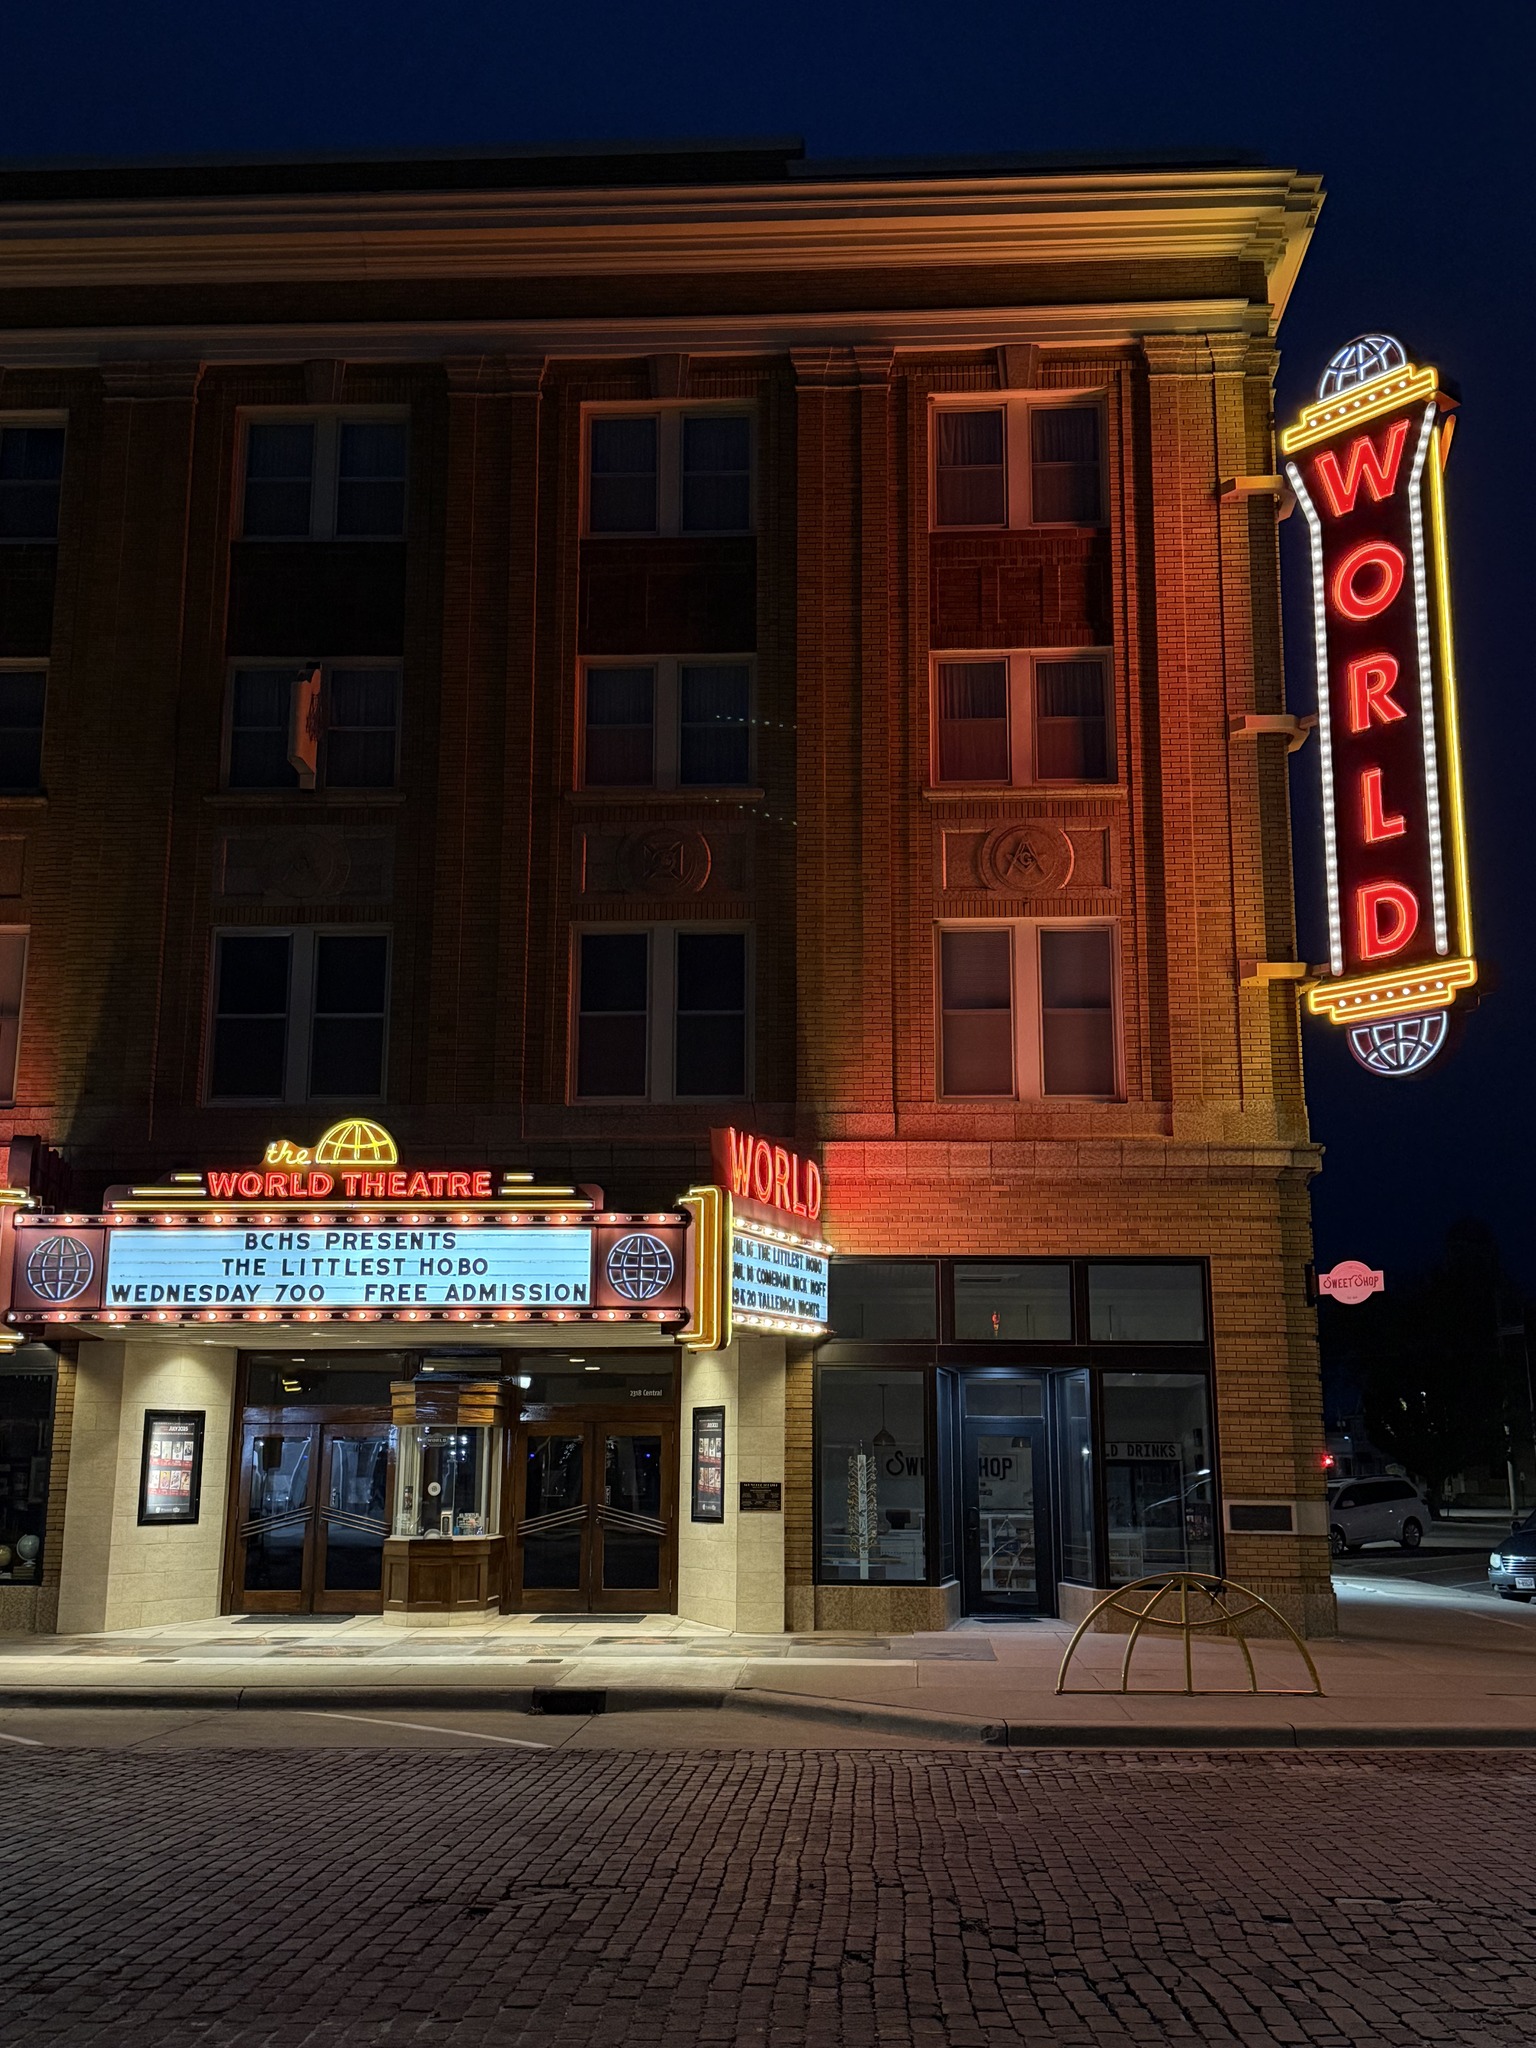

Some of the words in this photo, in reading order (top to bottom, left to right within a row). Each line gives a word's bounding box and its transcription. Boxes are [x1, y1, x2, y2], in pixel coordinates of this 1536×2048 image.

[1314, 420, 1420, 962] WORLD
[266, 1142, 311, 1165] the
[207, 1171, 335, 1198] WORLD
[341, 1171, 493, 1198] THEATRE
[728, 1126, 822, 1220] WORLD
[245, 1232, 310, 1251] BCHS
[325, 1232, 457, 1251] PRESENTS
[222, 1258, 267, 1277] THE
[281, 1258, 406, 1277] LITTLEST
[419, 1257, 489, 1276] HOBO
[758, 1243, 771, 1263] THE
[773, 1247, 804, 1270] LITTLEST
[805, 1255, 823, 1274] HOBO
[757, 1267, 791, 1290] COMEDIAN
[111, 1283, 262, 1302] WEDNESDAY
[275, 1283, 326, 1302] 700
[364, 1283, 428, 1302] FREE
[444, 1283, 588, 1302] ADMISSION
[643, 1389, 663, 1397] Central
[1127, 1444, 1176, 1457] DRINKS
[978, 1457, 1012, 1480] HOP
